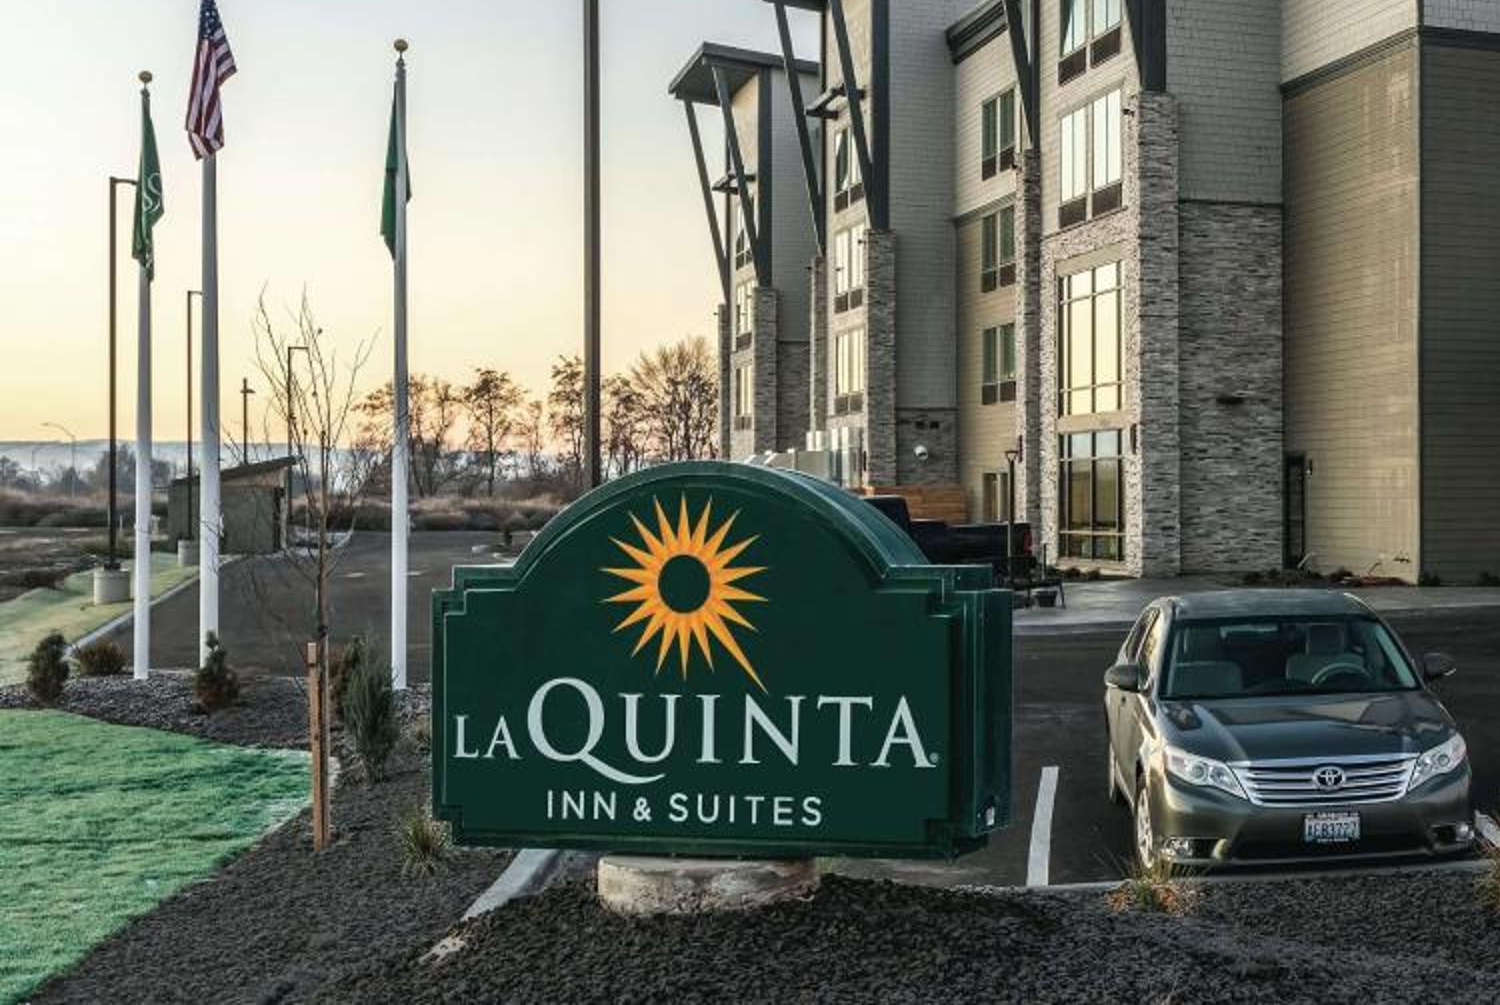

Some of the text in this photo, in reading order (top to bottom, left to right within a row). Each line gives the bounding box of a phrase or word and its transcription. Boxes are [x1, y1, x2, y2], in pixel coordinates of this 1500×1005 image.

[453, 677, 938, 784] LA QUINTA
[546, 790, 823, 827] INN & SUITES
